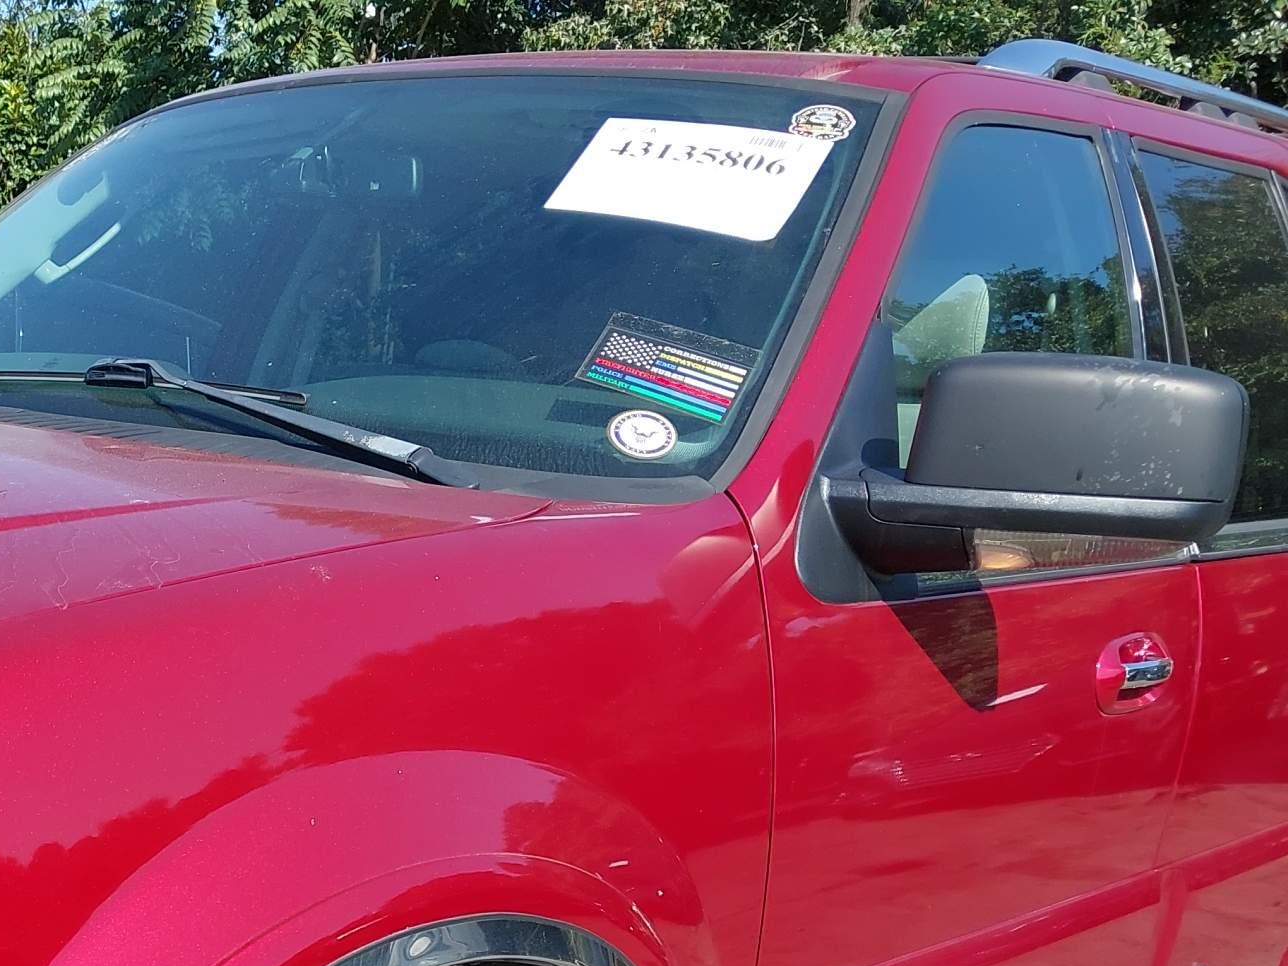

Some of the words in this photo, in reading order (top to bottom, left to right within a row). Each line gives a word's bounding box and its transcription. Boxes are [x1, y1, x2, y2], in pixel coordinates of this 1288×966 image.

[610, 140, 786, 175] 43135806
[655, 359, 677, 370] EMS
[663, 346, 730, 370] CORRECTIONS
[586, 371, 631, 391] MILITARY
[591, 364, 624, 379] POLICE
